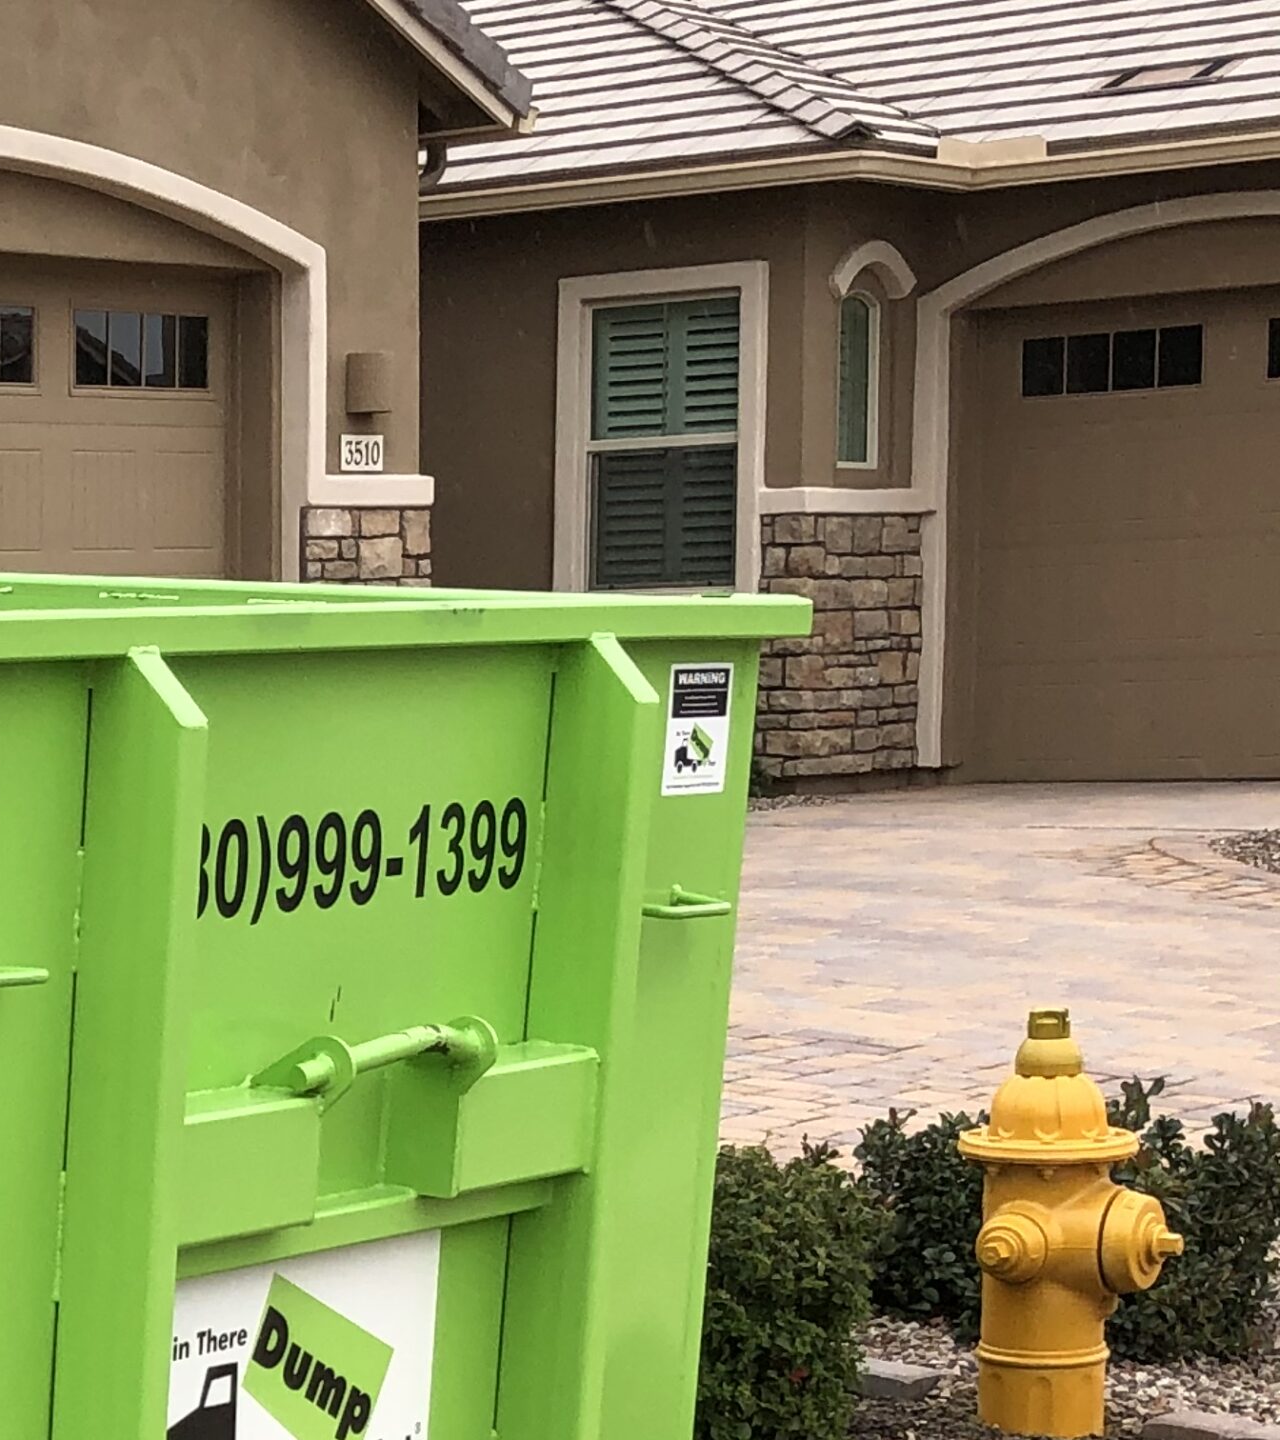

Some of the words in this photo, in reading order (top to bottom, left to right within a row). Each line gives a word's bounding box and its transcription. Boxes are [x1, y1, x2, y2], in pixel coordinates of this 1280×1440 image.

[345, 440, 380, 466] 3510
[678, 672, 726, 685] WARNING
[197, 797, 527, 926] 0)999-1399
[172, 1336, 189, 1362] in
[197, 1328, 248, 1356] There
